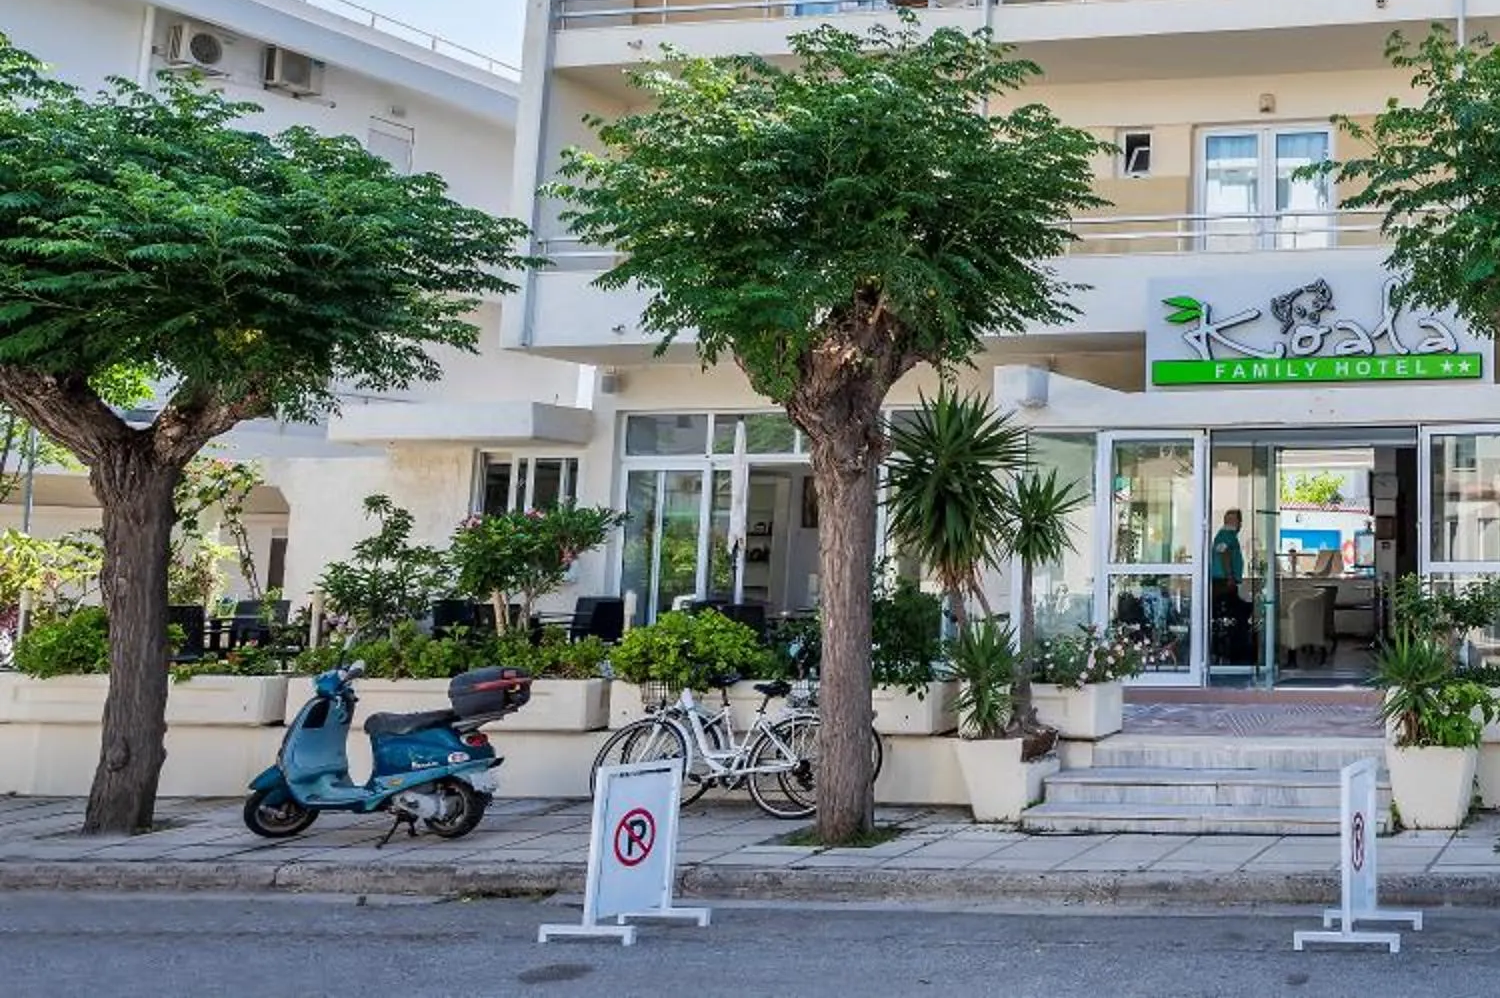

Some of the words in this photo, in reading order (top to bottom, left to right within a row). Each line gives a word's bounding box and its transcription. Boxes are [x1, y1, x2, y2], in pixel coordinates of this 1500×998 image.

[1183, 276, 1459, 360] Koala
[1214, 361, 1318, 379] FAMILY
[1335, 359, 1428, 376] HOTEL
